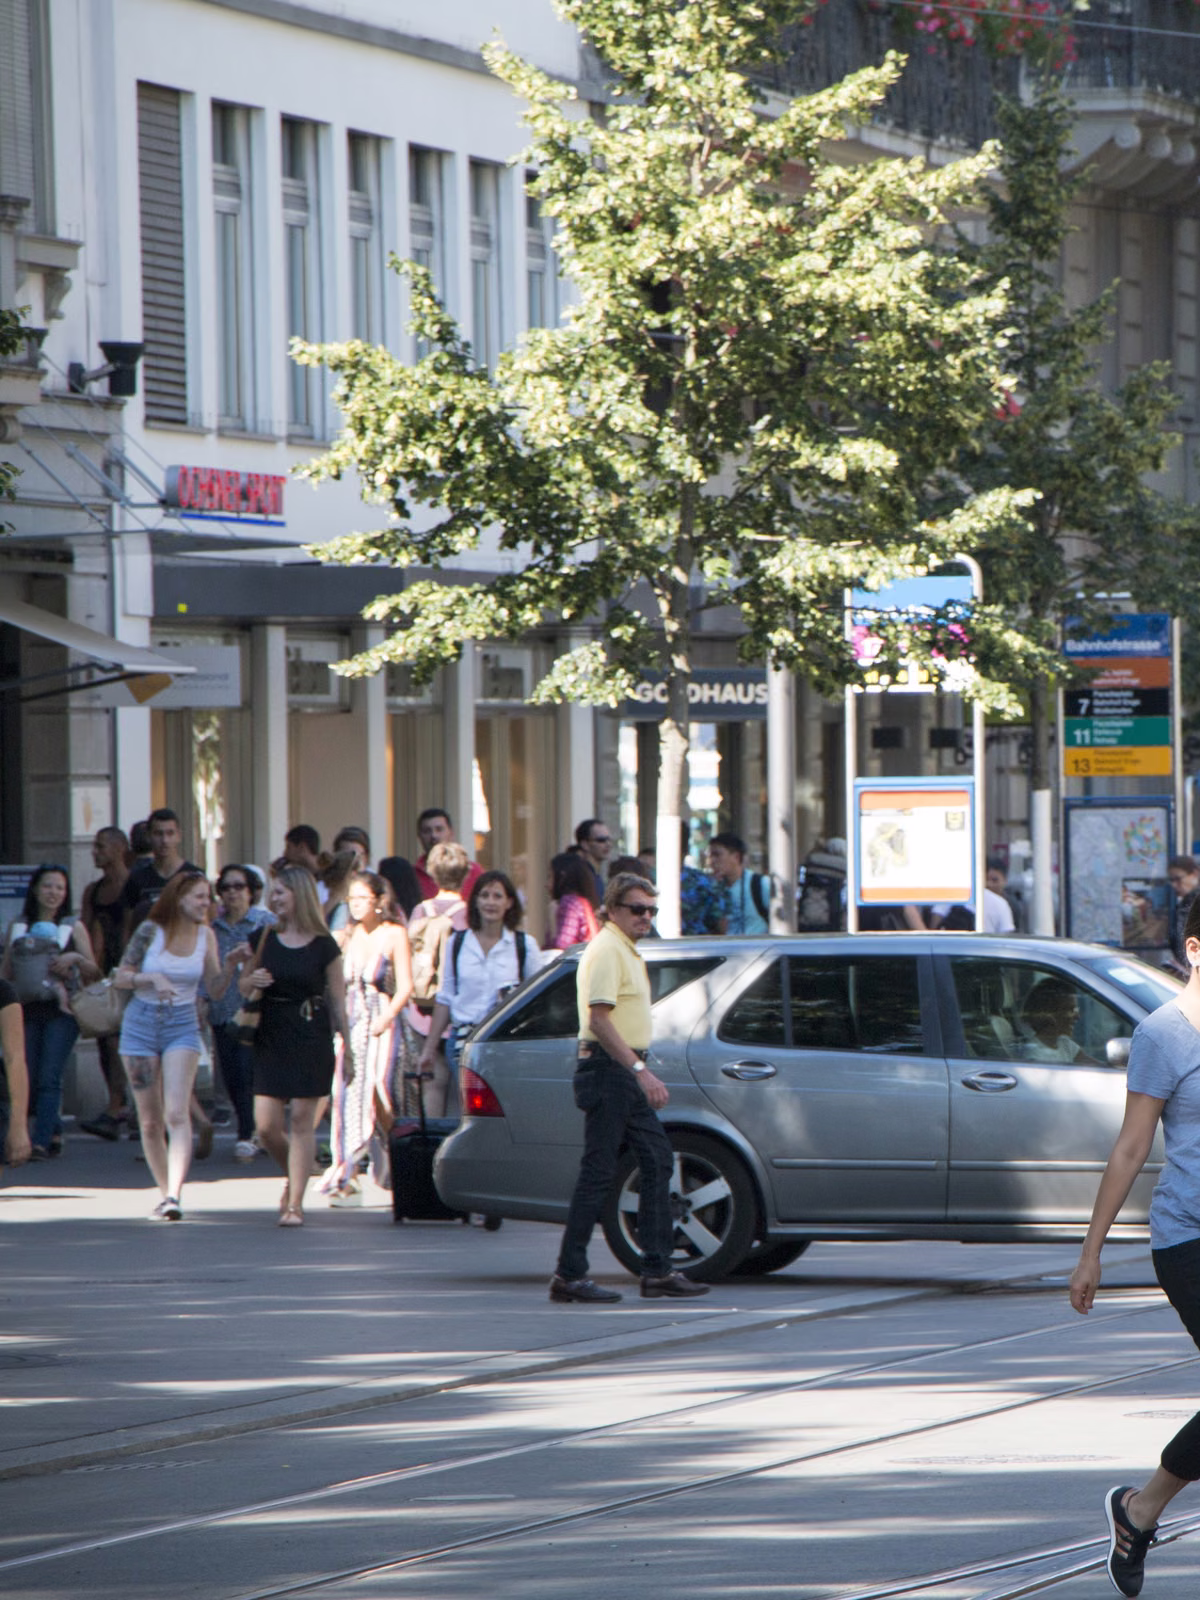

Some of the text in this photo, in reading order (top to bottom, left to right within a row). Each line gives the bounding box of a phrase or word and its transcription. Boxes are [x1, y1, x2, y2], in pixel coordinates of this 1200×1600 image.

[1066, 639, 1161, 652] Bahnhofstrasse
[636, 682, 768, 704] GODHAUS
[1078, 698, 1090, 714] 7
[1073, 728, 1091, 744] 11
[1072, 758, 1090, 773] 13
